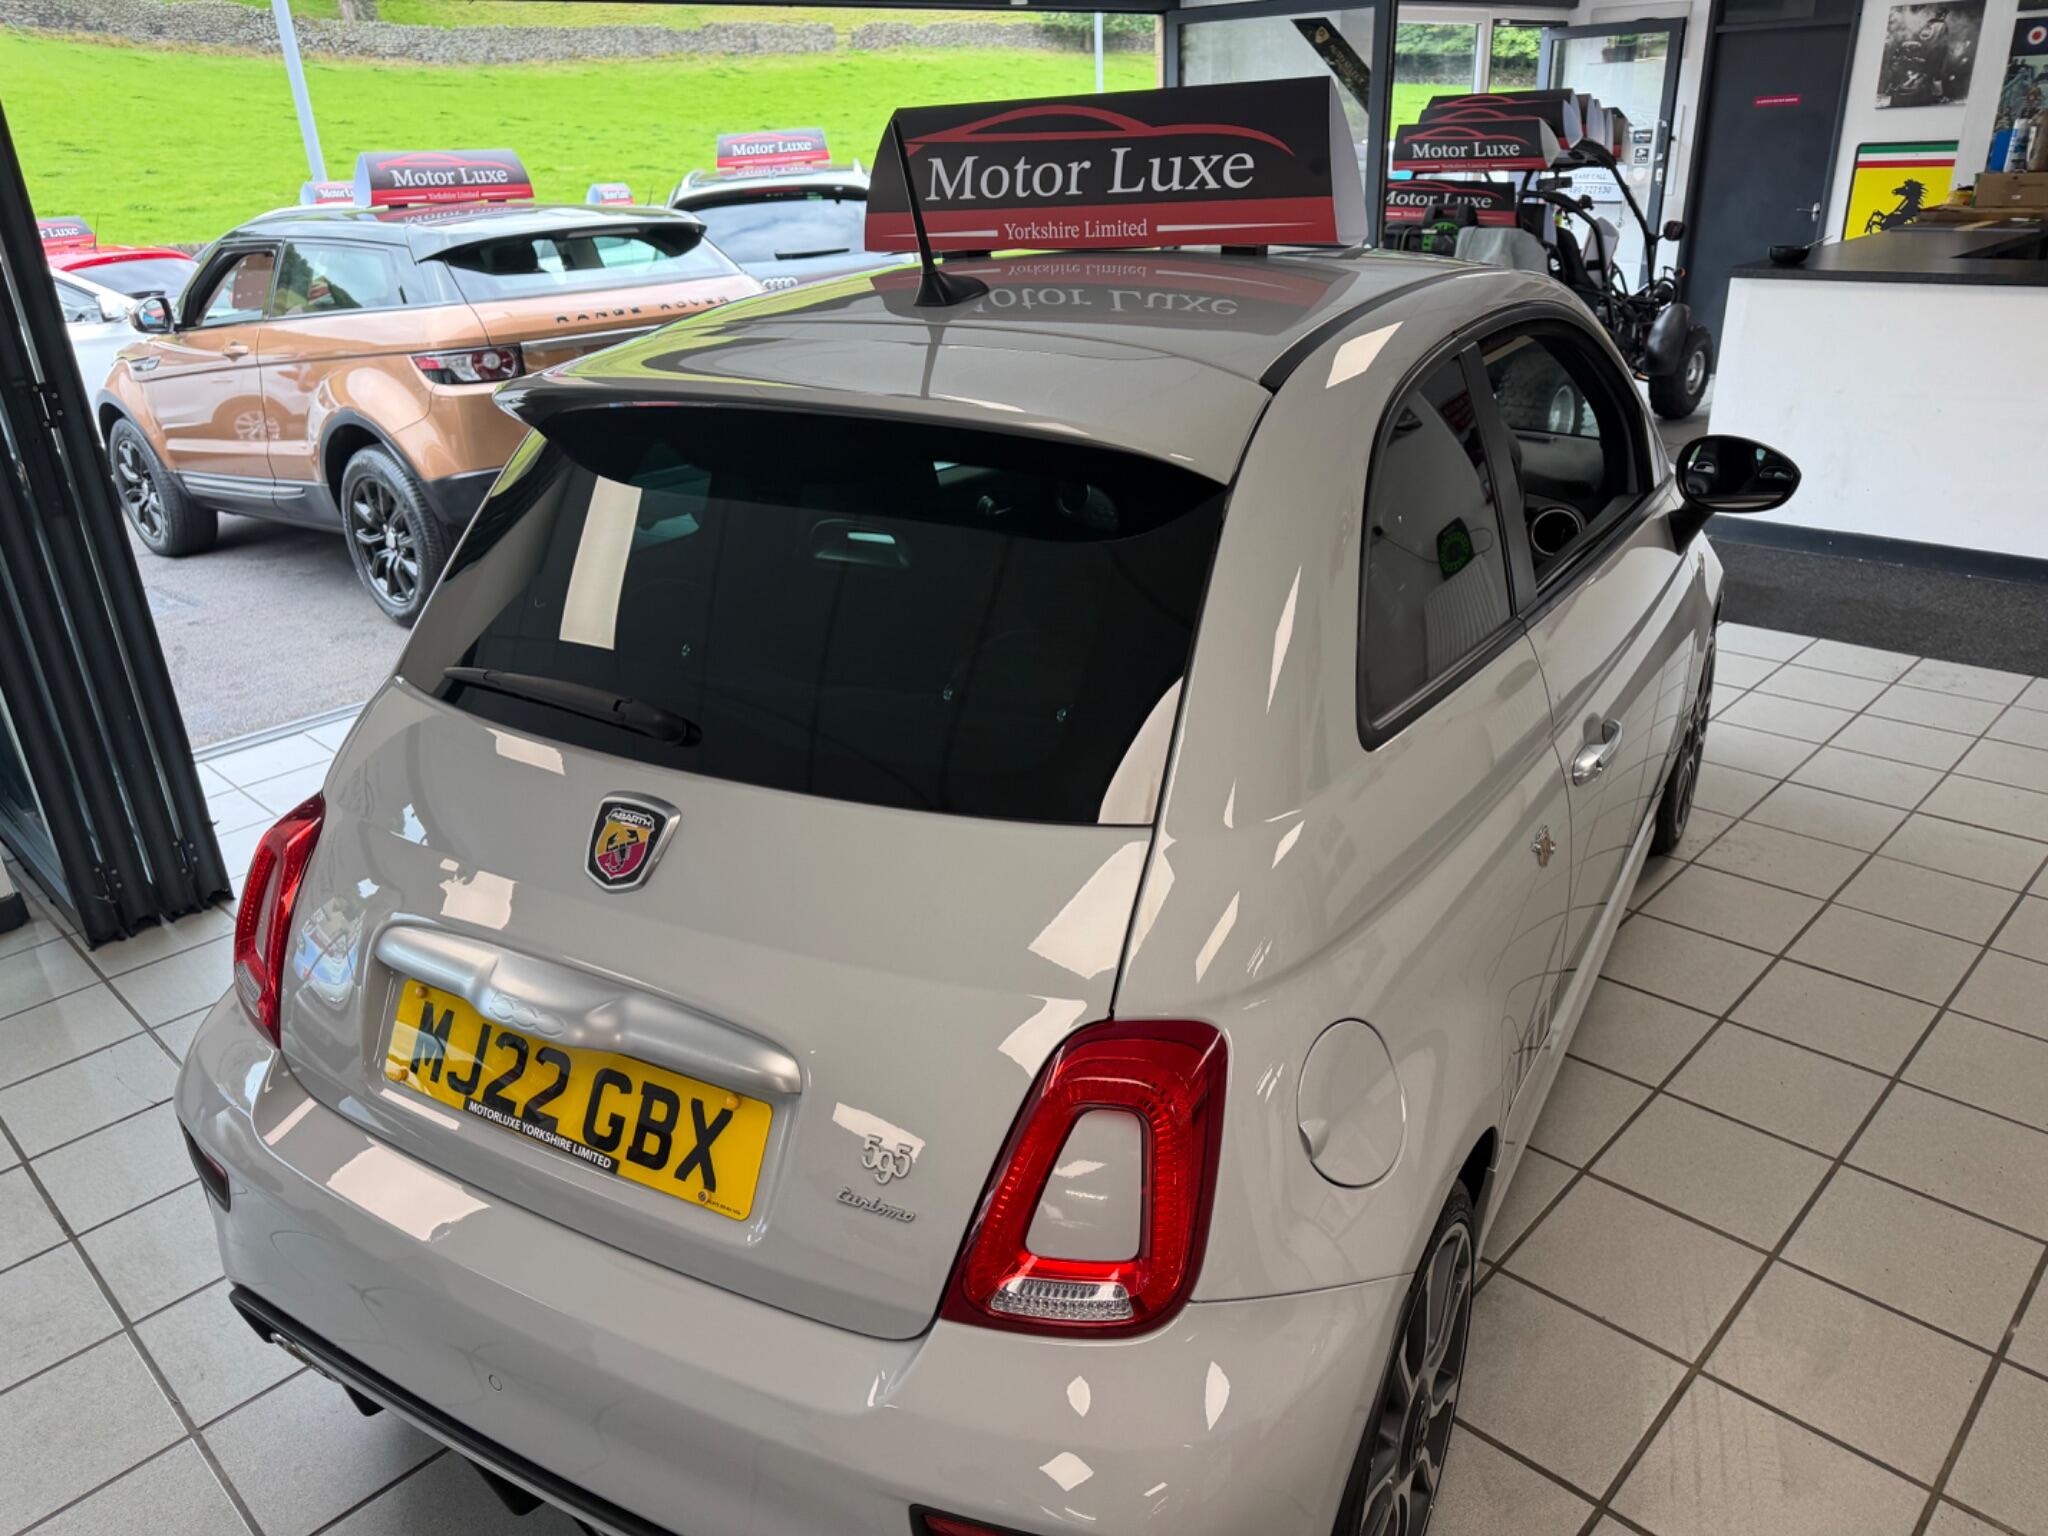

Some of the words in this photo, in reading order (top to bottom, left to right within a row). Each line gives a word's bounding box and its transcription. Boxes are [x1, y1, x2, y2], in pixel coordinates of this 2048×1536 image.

[731, 143, 775, 156] Motor
[778, 140, 812, 153] Luxe
[1411, 142, 1468, 159] Motor
[1473, 141, 1520, 157] Luxe
[390, 168, 455, 188] Motor
[458, 167, 508, 184] Luxe
[925, 155, 1091, 201] Motor
[1107, 147, 1255, 194] Luxe
[1004, 222, 1081, 241] Yorkshire
[1085, 218, 1148, 238] Limited
[556, 306, 642, 324] RANGE
[610, 811, 652, 828] ABARTH
[409, 1001, 571, 1134] MJ22
[581, 1067, 734, 1192] GBX
[468, 1100, 521, 1131] MOTORLUXE
[521, 1121, 572, 1152] YORKSHIRE
[572, 1143, 612, 1169] LIMITED
[861, 1133, 914, 1185] 595
